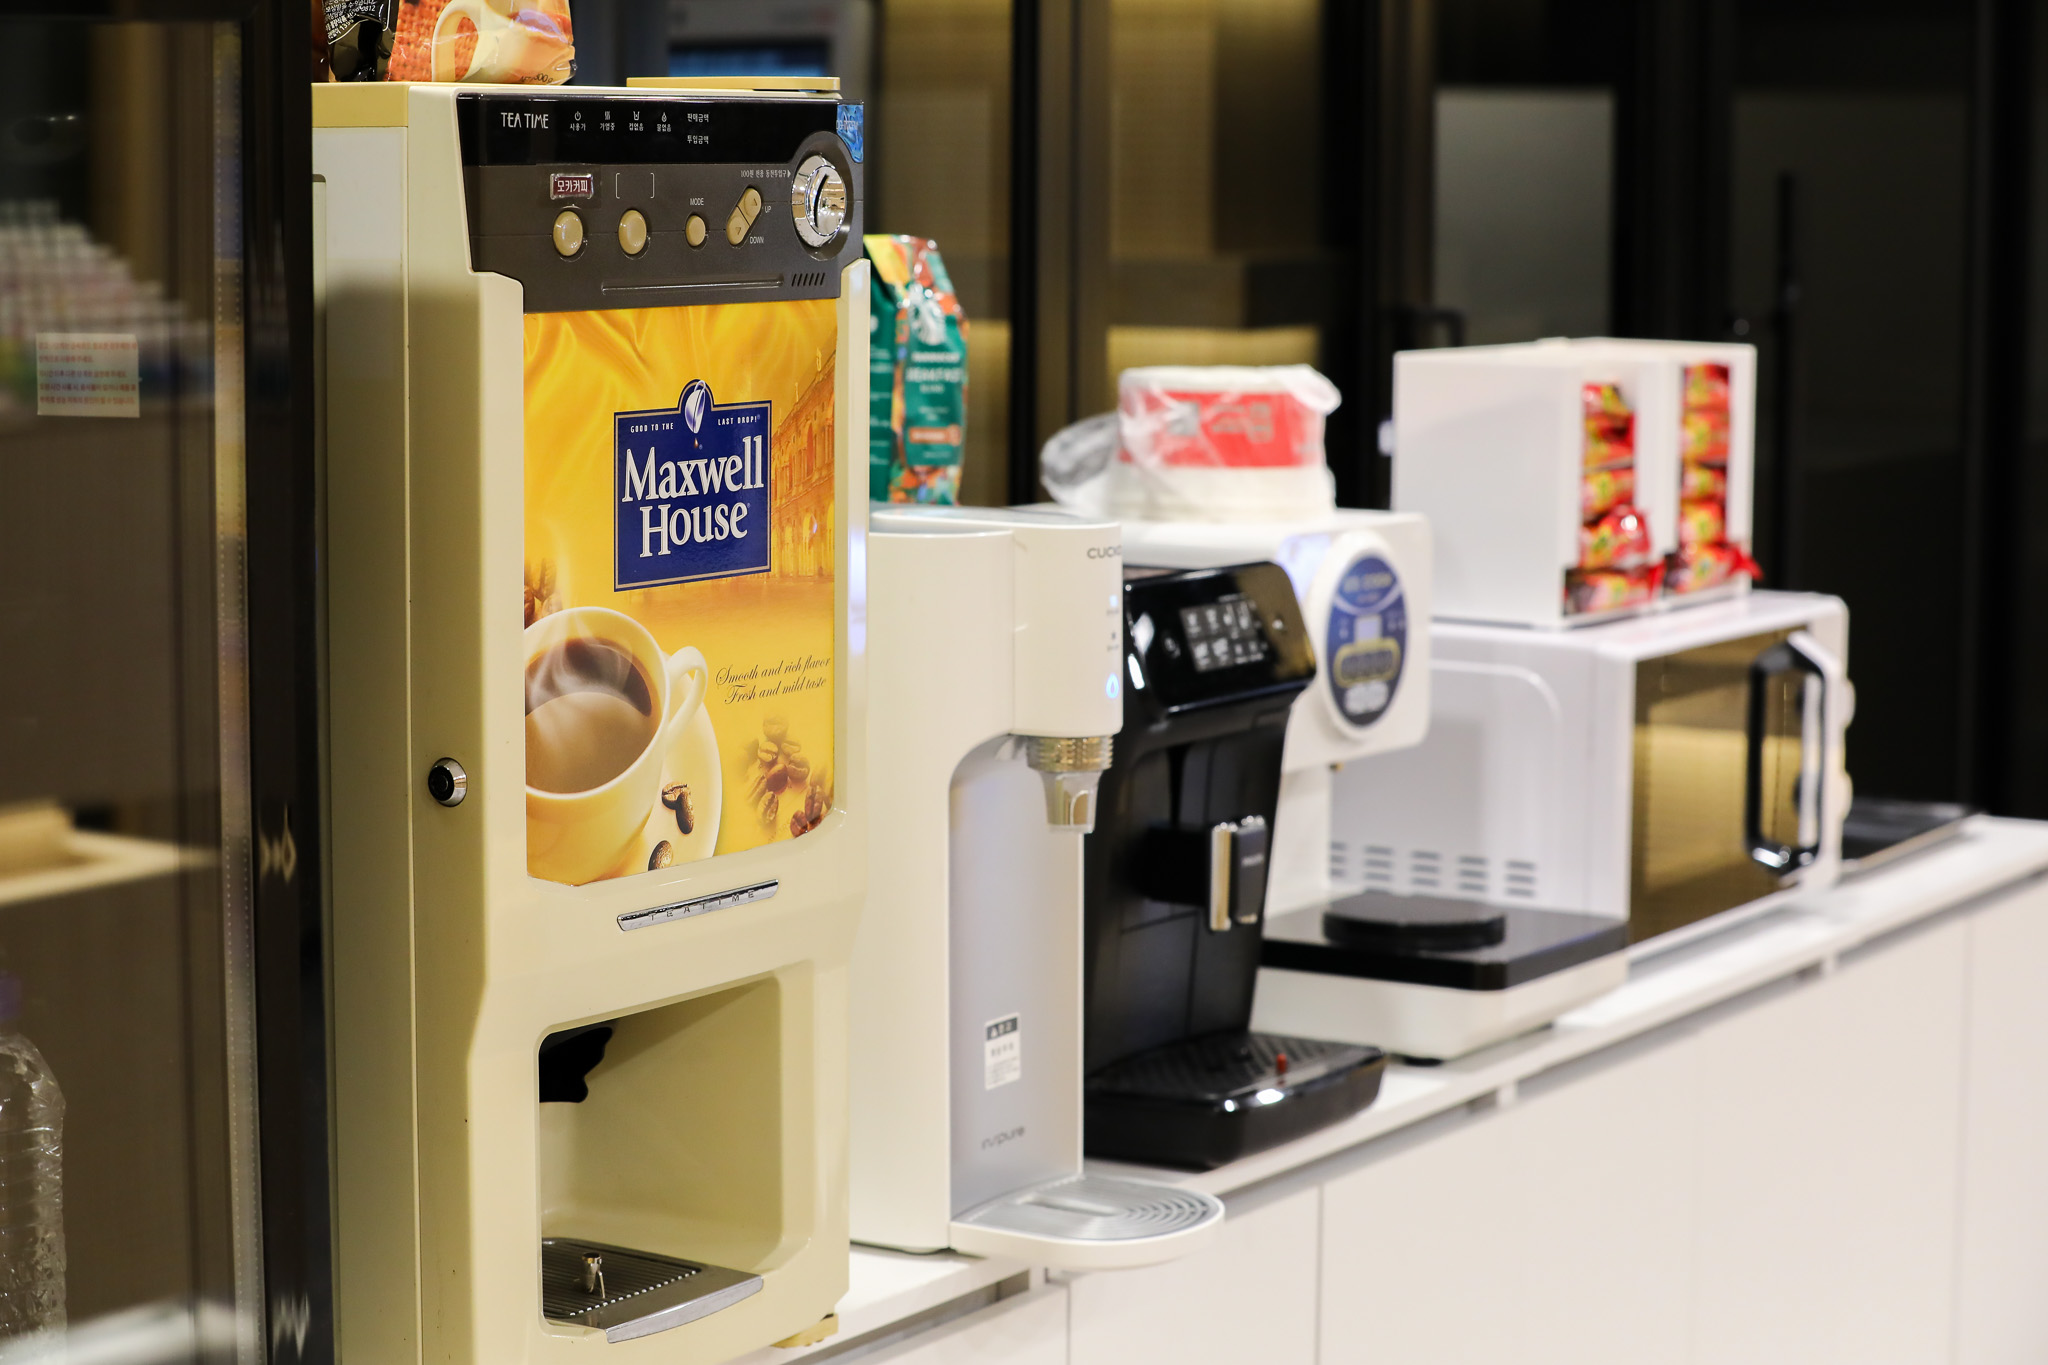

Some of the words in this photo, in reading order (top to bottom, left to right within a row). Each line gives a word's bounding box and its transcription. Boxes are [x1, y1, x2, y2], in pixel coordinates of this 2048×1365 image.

[501, 112, 521, 128] TEA
[524, 113, 549, 129] TIME
[687, 113, 709, 122] 판매금액
[687, 135, 709, 144] 투입금액
[557, 180, 588, 192] 모카커피
[690, 198, 704, 206] MODE
[764, 205, 772, 213] UP
[749, 236, 764, 244] DOWN
[630, 425, 648, 433] GOOD
[662, 422, 674, 430] THE
[717, 417, 734, 426] LAST
[737, 416, 757, 424] DROP!
[622, 434, 764, 502] Maxwell
[639, 502, 748, 557] House
[715, 664, 758, 687] Smooth
[761, 660, 783, 677] and
[784, 657, 801, 674] rich
[800, 655, 831, 676] flavor
[724, 684, 756, 704] Fresh
[759, 681, 781, 698] and
[782, 676, 806, 694] mild
[806, 677, 826, 689] taste
